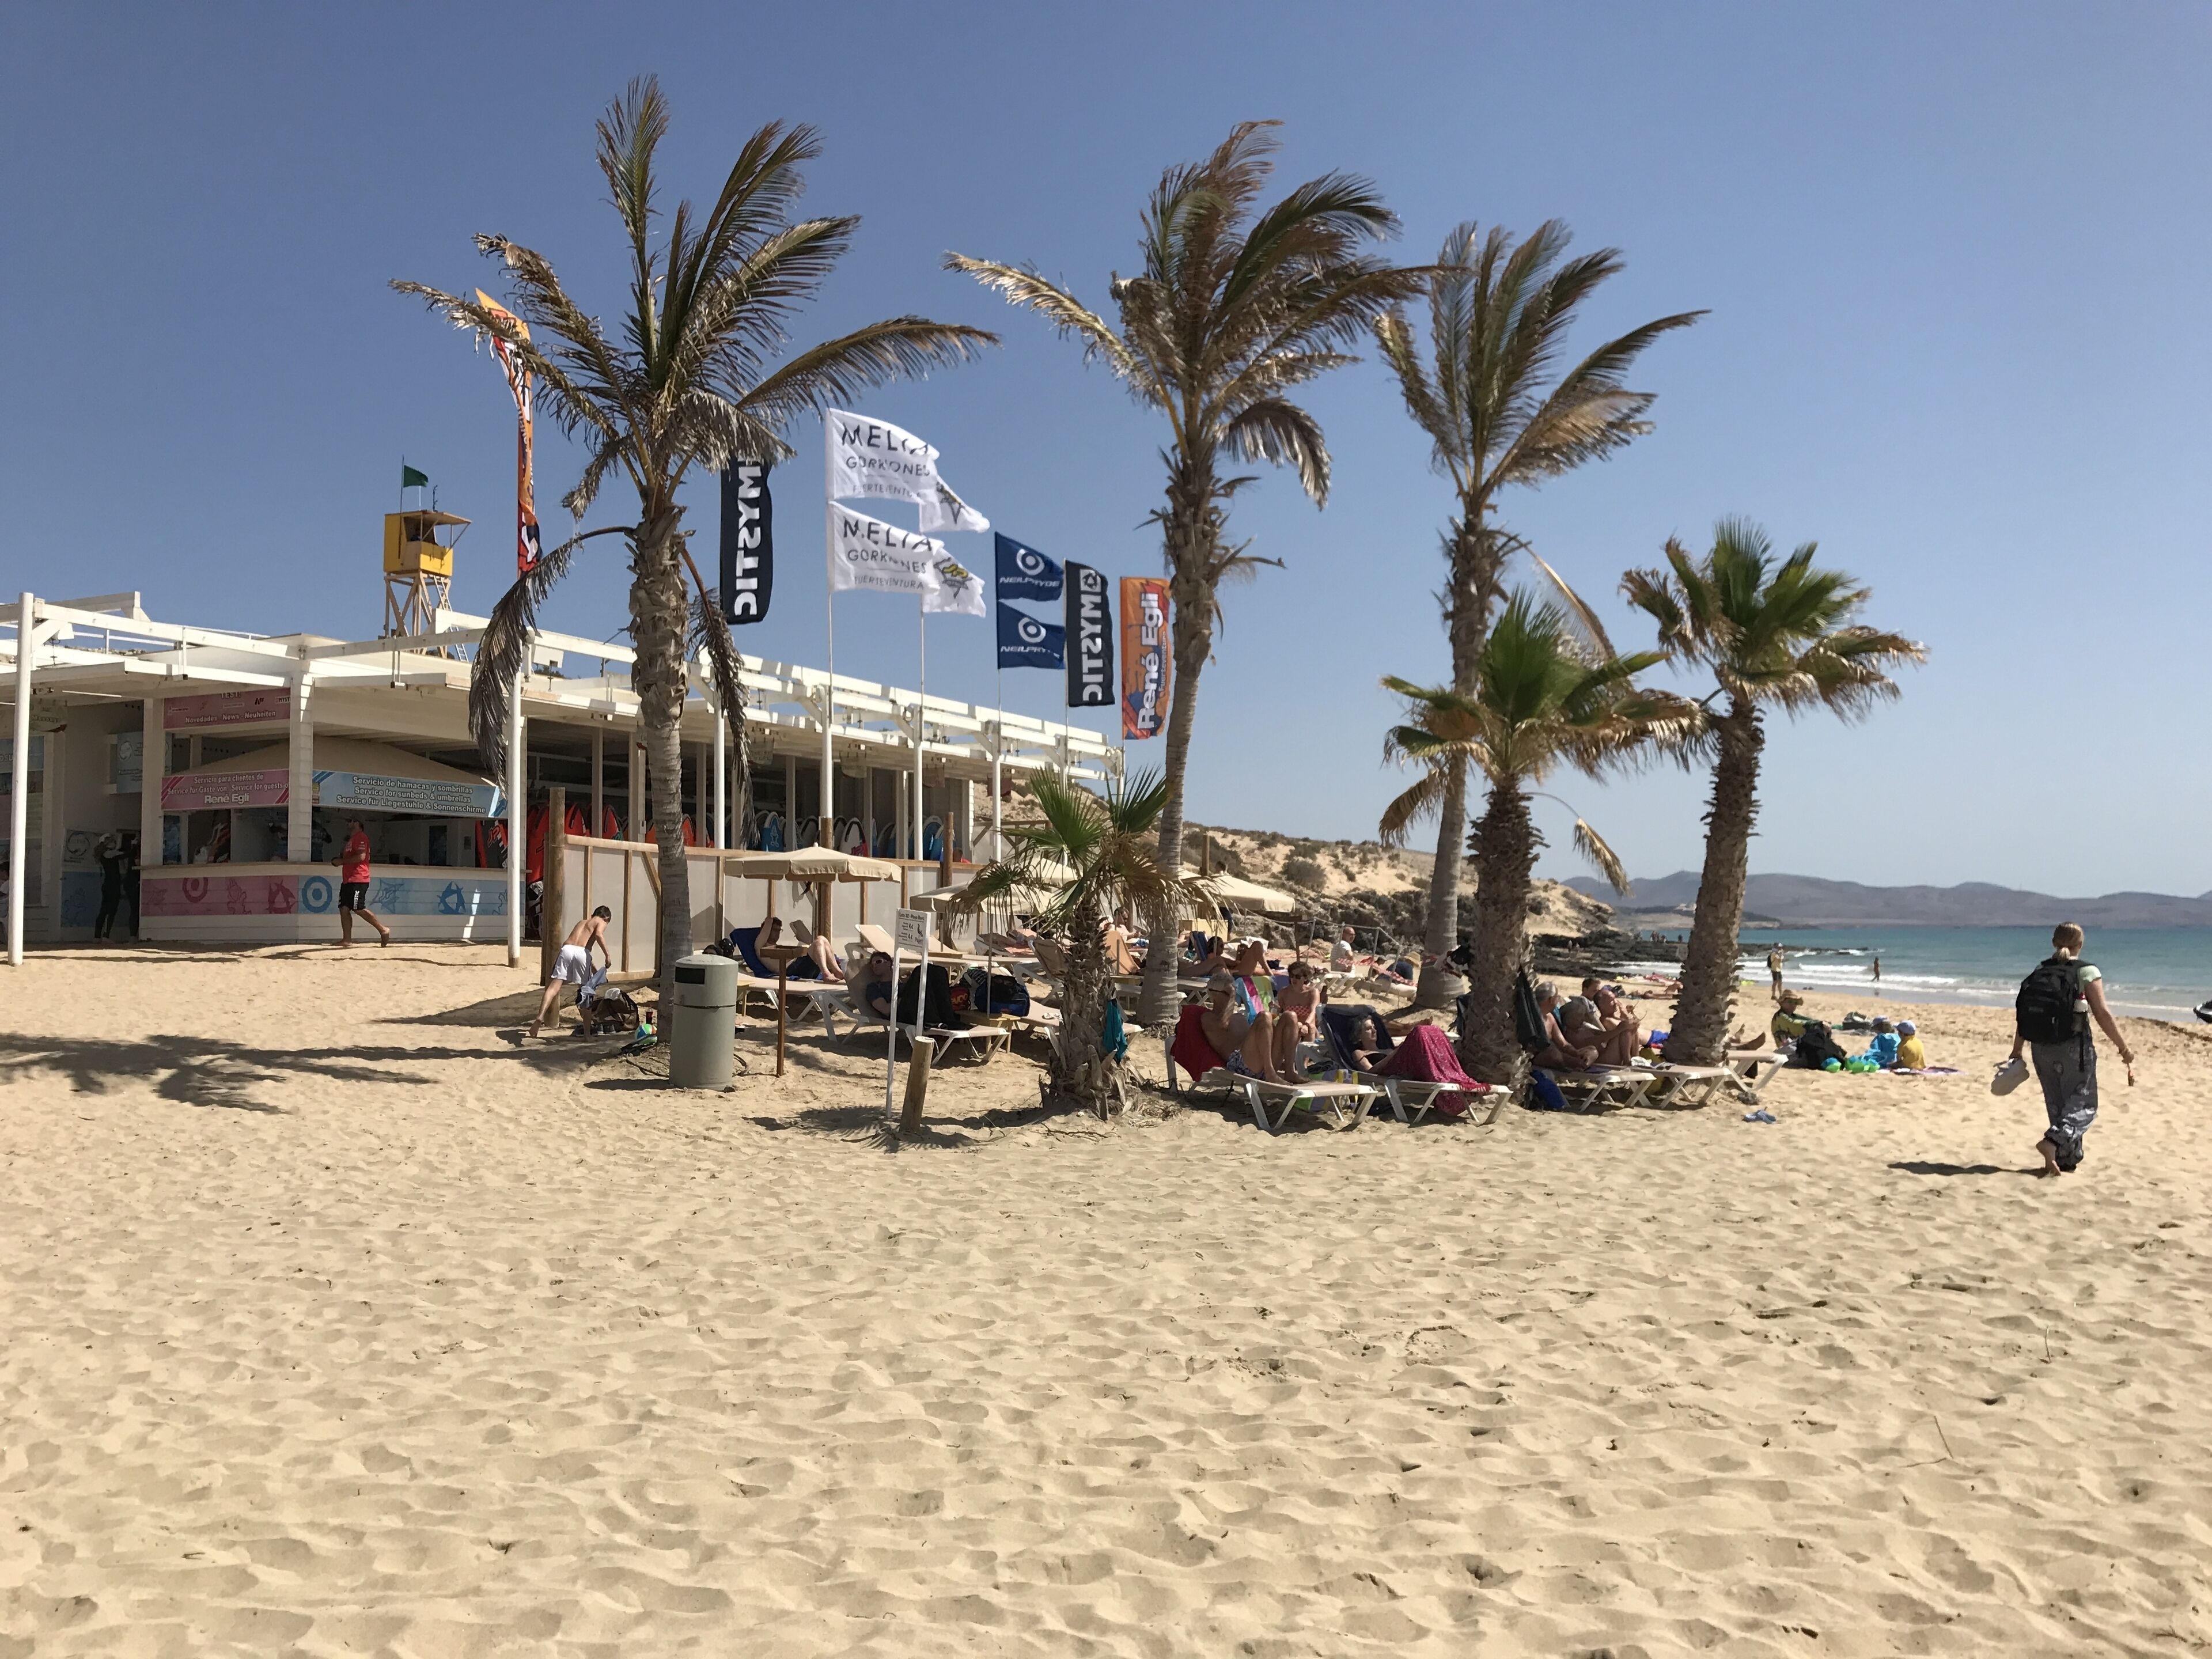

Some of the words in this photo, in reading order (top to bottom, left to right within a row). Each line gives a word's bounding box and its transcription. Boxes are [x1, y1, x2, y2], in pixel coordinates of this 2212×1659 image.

[999, 577, 1060, 587] NEILPRYDE
[1141, 593, 1164, 646] Egli
[1138, 652, 1160, 729] René
[244, 710, 276, 719] Neuheiten
[194, 776, 217, 784] Servicio
[232, 774, 255, 782] clientes
[256, 772, 264, 781] de
[353, 776, 384, 786] Servicio
[385, 779, 396, 787] de
[397, 781, 430, 790] hamacas
[437, 785, 473, 794] sombrillas
[167, 787, 188, 795] Service
[354, 787, 384, 796] Service
[385, 789, 396, 797] for
[397, 791, 428, 800] sunbeds
[437, 794, 471, 803] umbrellas
[204, 793, 230, 804] René
[232, 793, 249, 804] Egli
[336, 795, 366, 805] Service
[433, 803, 486, 814] Sonnenschirme
